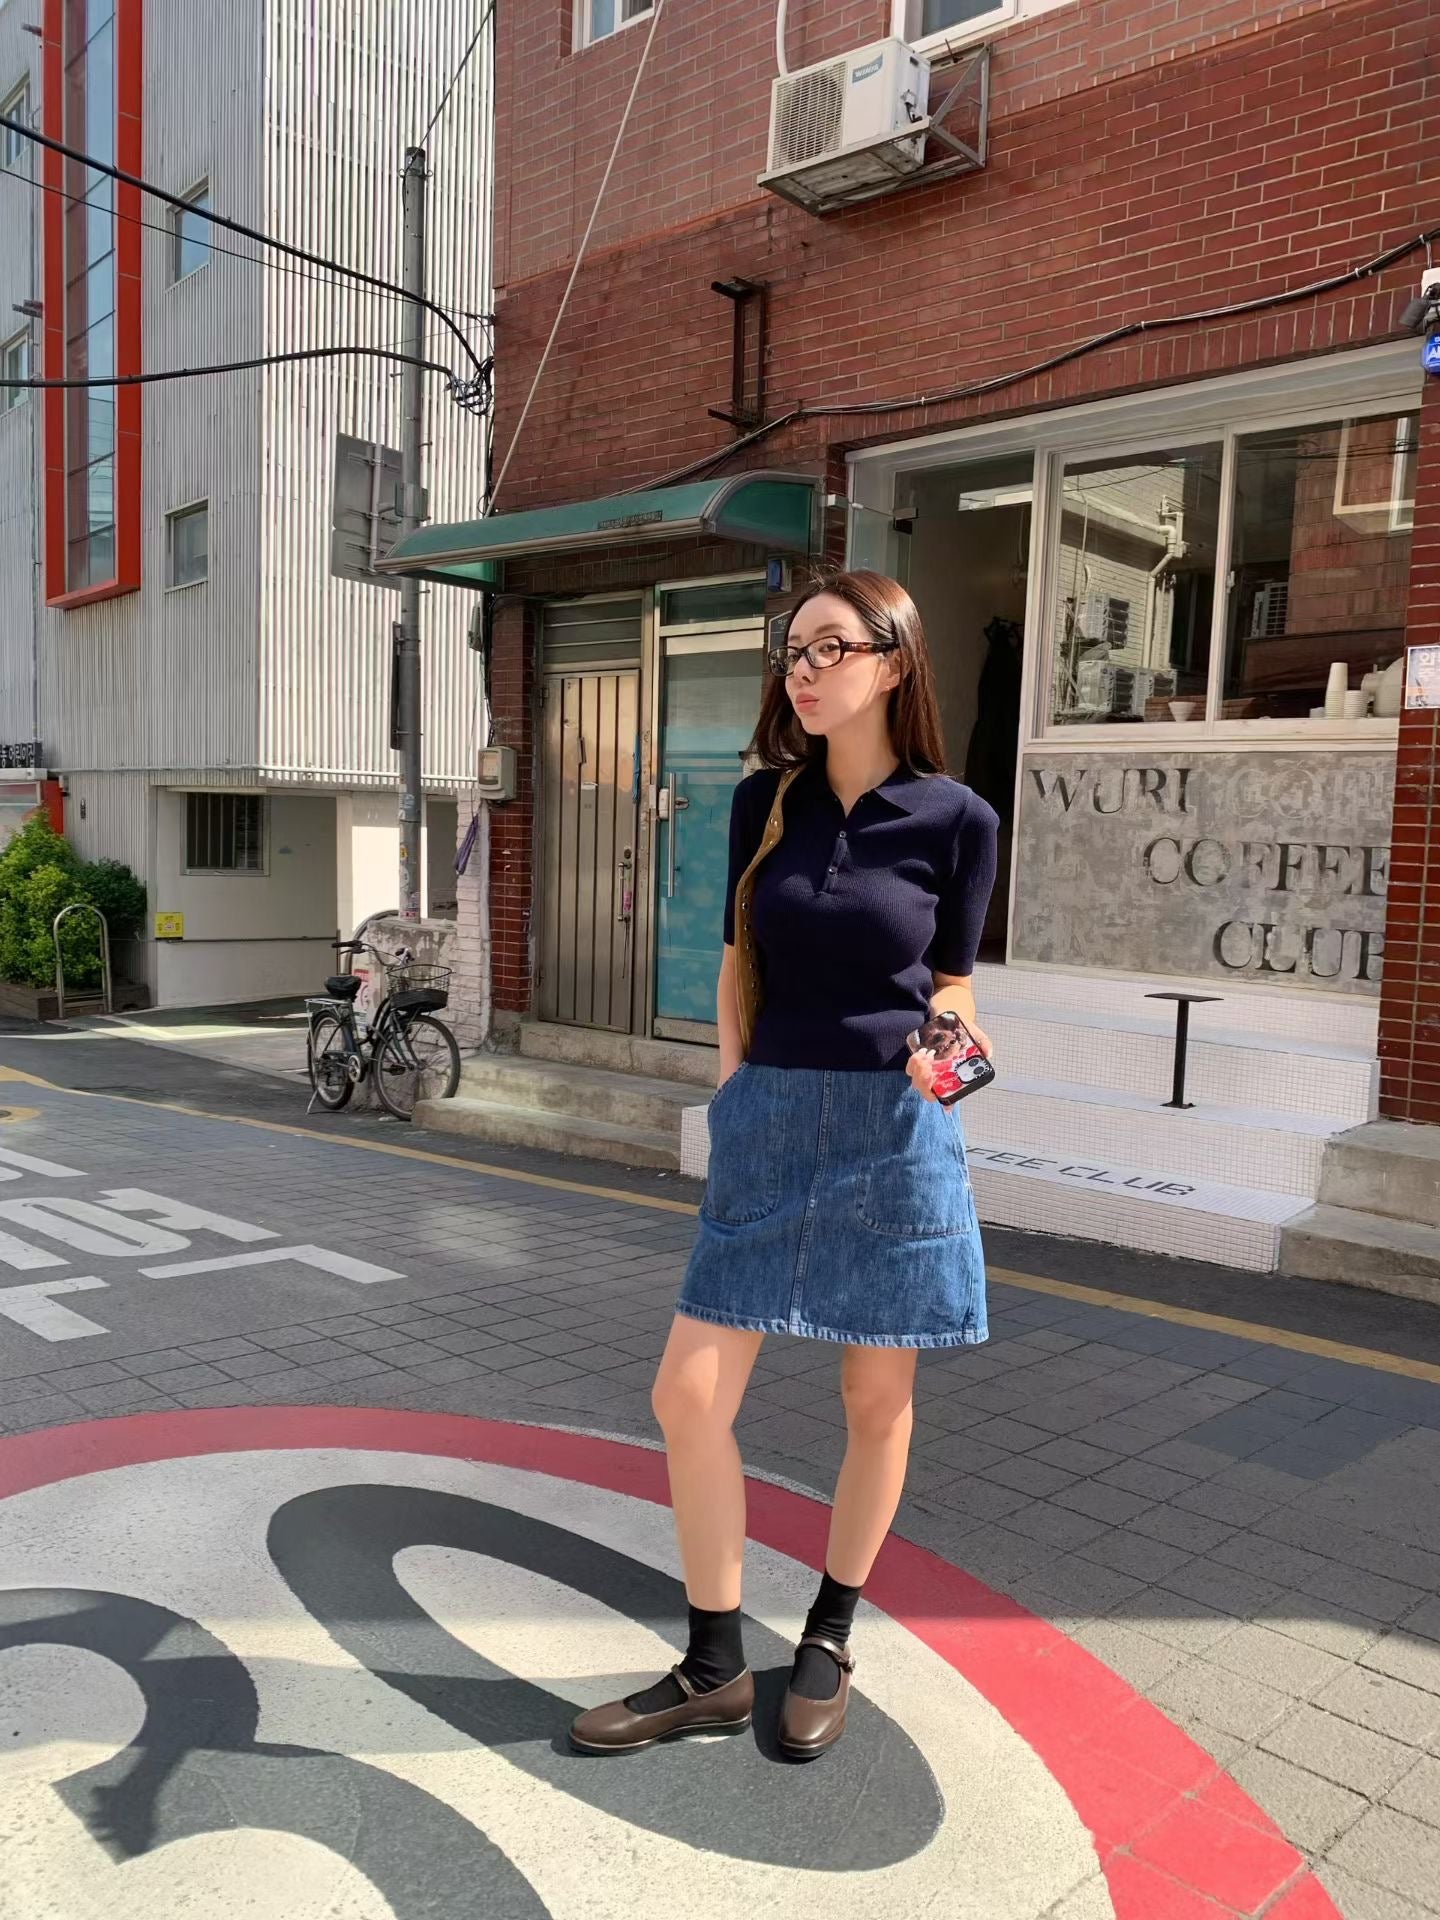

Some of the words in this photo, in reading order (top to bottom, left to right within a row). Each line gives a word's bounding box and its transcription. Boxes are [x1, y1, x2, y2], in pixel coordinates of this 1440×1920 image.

[1028, 767, 1193, 815] WURI
[966, 1146, 1058, 1170] FEE
[1059, 1165, 1197, 1196] CLUB
